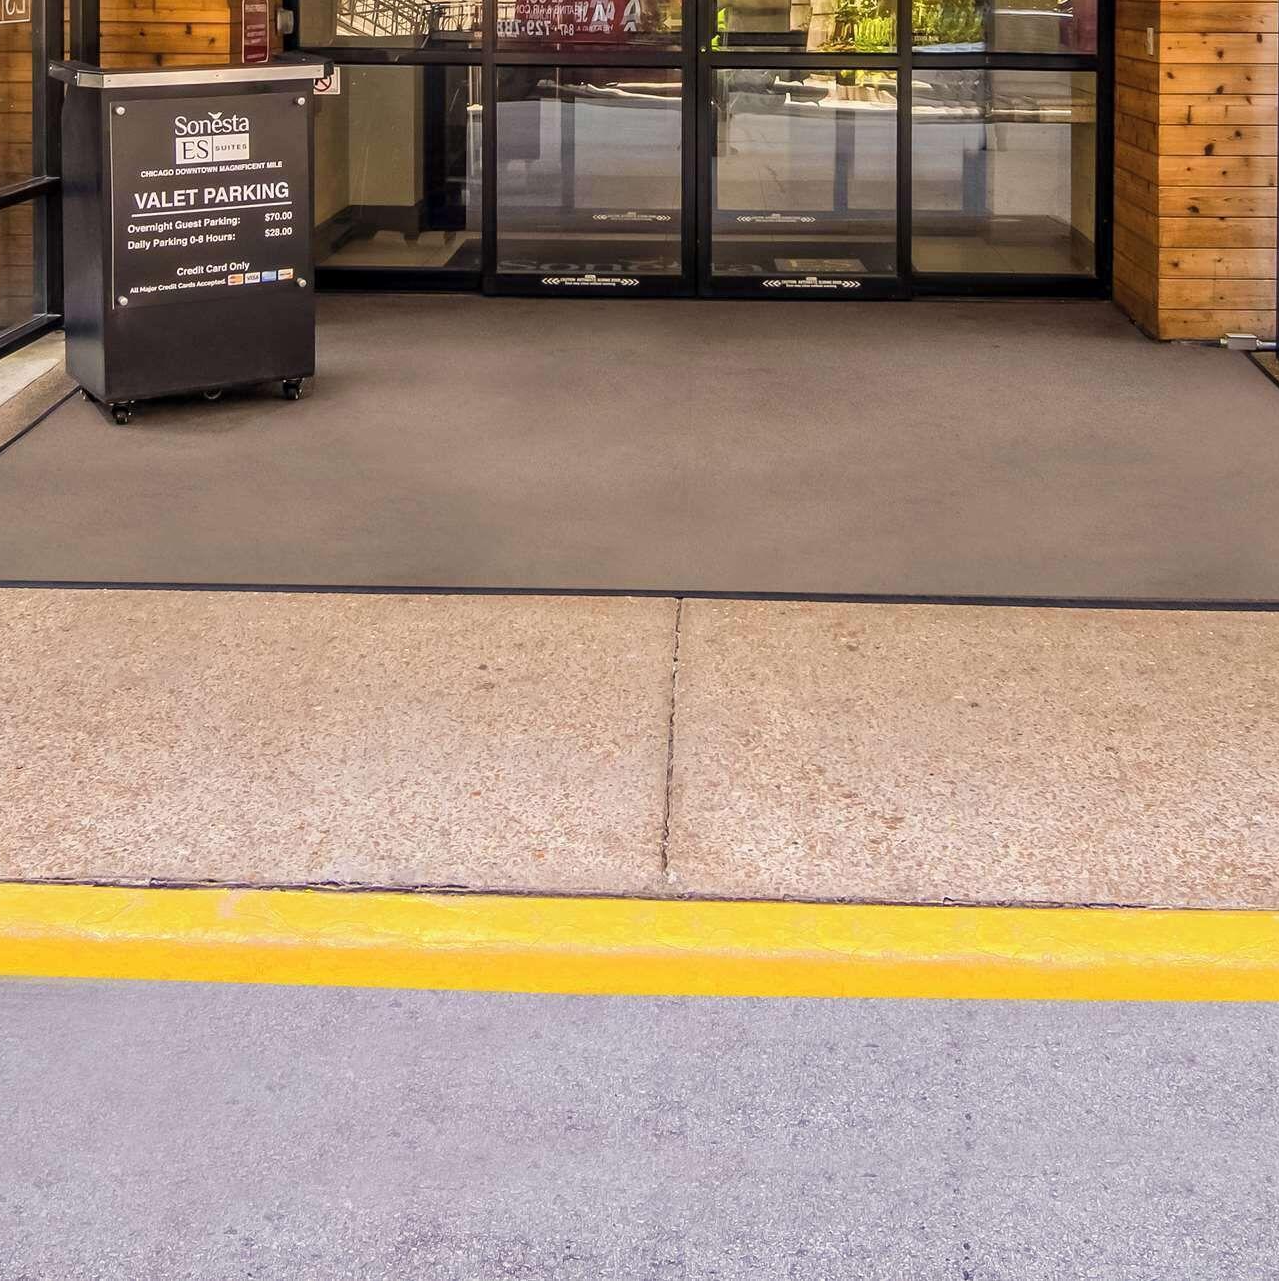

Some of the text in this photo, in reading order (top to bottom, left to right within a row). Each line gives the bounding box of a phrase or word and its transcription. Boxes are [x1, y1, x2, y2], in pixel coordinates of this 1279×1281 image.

[182, 139, 247, 160] ES SUITES
[141, 161, 283, 178] CHICAGO DOWNTOWN MAGNIFICENT MILE
[134, 182, 289, 209] VALET PARKING
[127, 211, 293, 234] Overnight Guest Parking: $70.00
[127, 239, 151, 250] Daily
[153, 237, 188, 247] Parking
[205, 233, 236, 243] Hours:
[176, 261, 250, 276] Credit Card Only
[129, 286, 139, 294] All
[139, 285, 158, 293] Major
[158, 283, 177, 291] Credit
[177, 281, 196, 289] Cards
